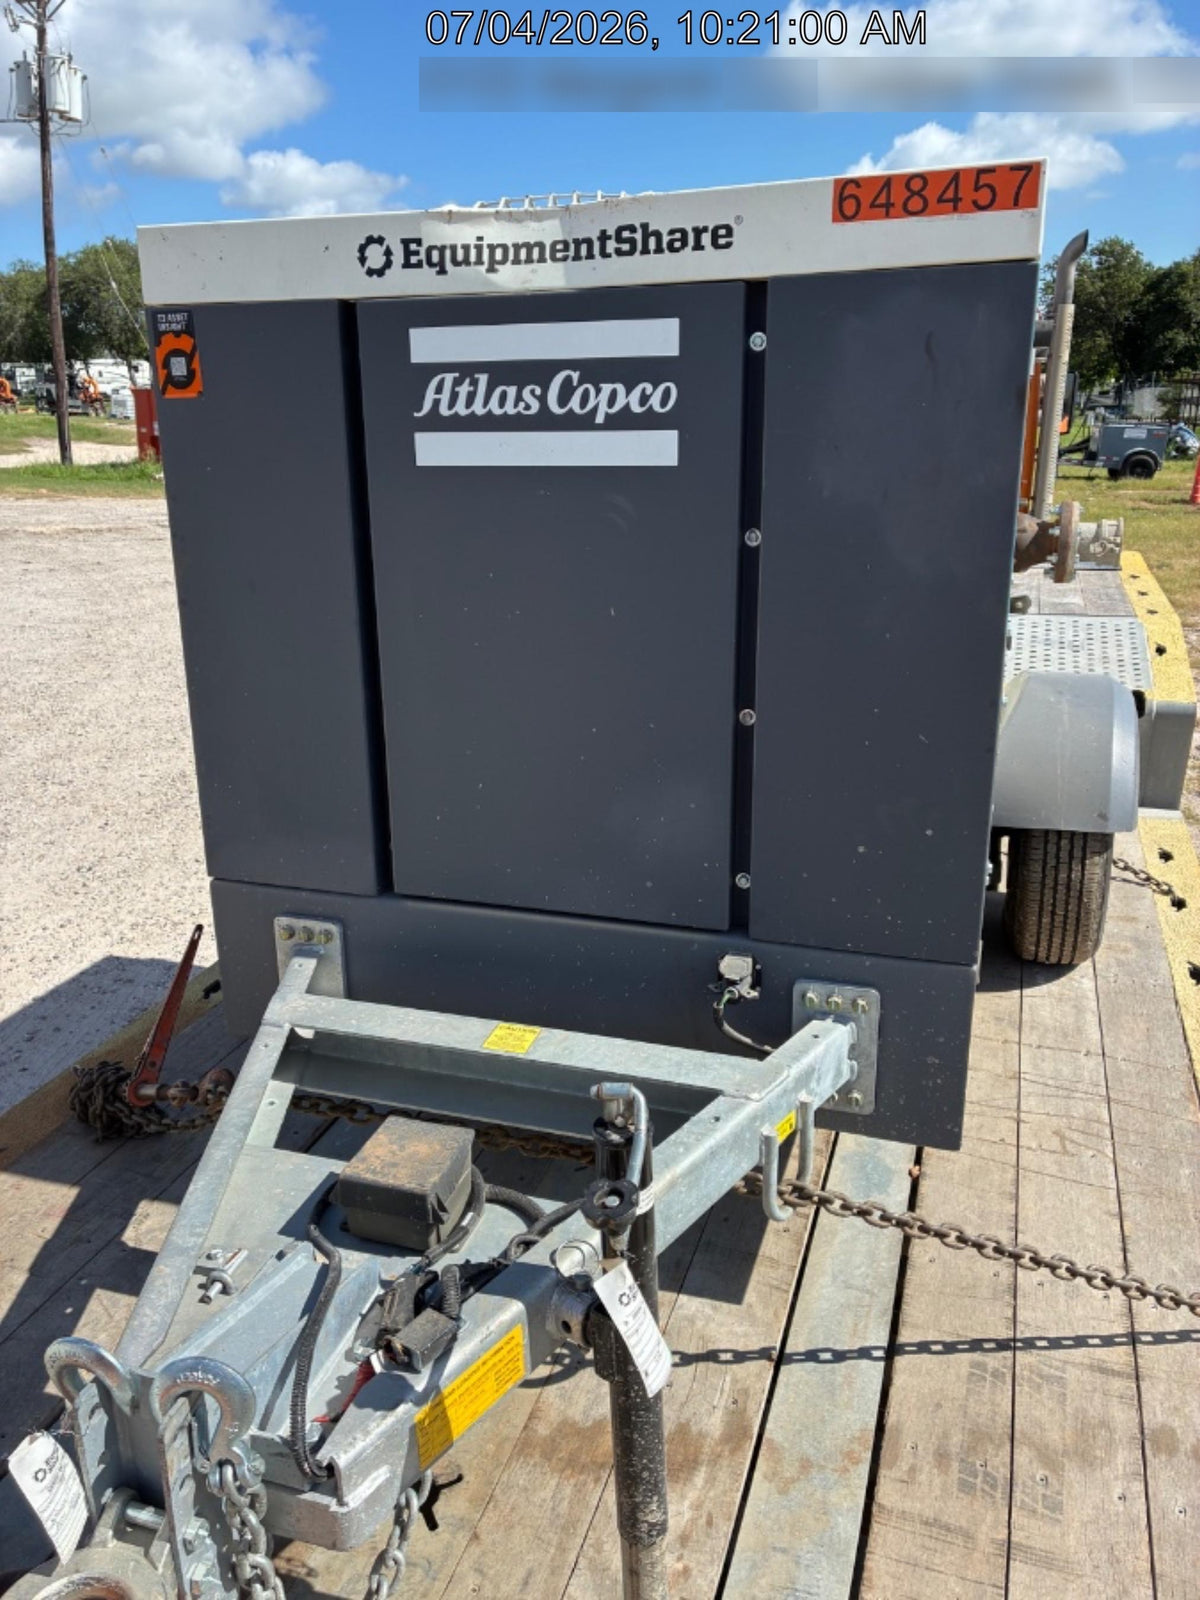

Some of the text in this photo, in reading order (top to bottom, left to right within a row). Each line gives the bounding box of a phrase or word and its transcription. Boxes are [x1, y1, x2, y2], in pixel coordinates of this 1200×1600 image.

[837, 164, 1034, 222] 648457
[413, 369, 678, 424] Atlas Copco
